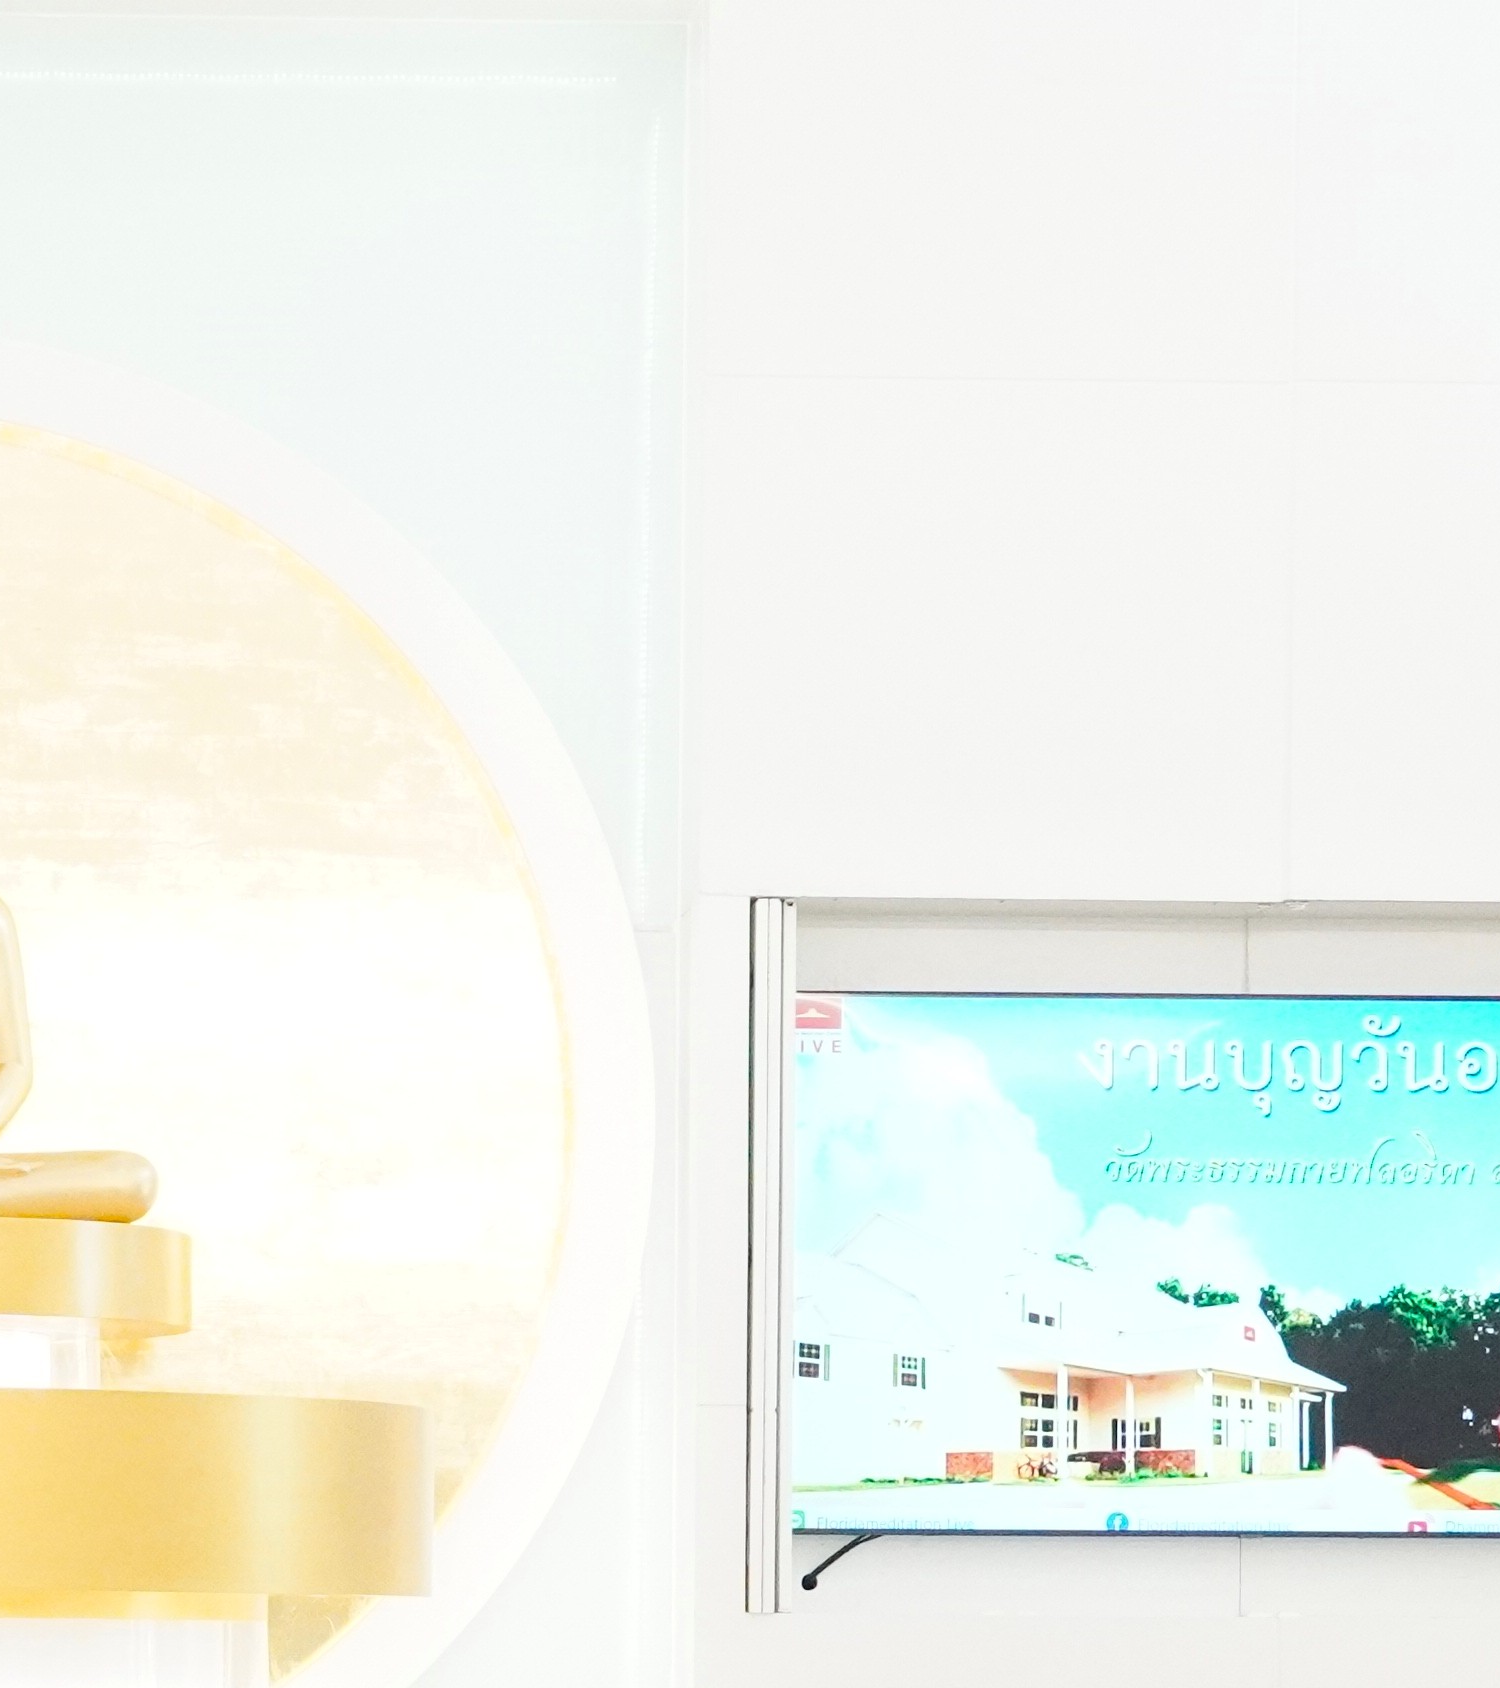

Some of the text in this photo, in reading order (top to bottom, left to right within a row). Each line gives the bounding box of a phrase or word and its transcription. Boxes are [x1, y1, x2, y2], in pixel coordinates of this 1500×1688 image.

[800, 1039, 842, 1053] IVE
[1105, 1129, 1476, 1185] วัดพระธรรมกายฟลอริดา
